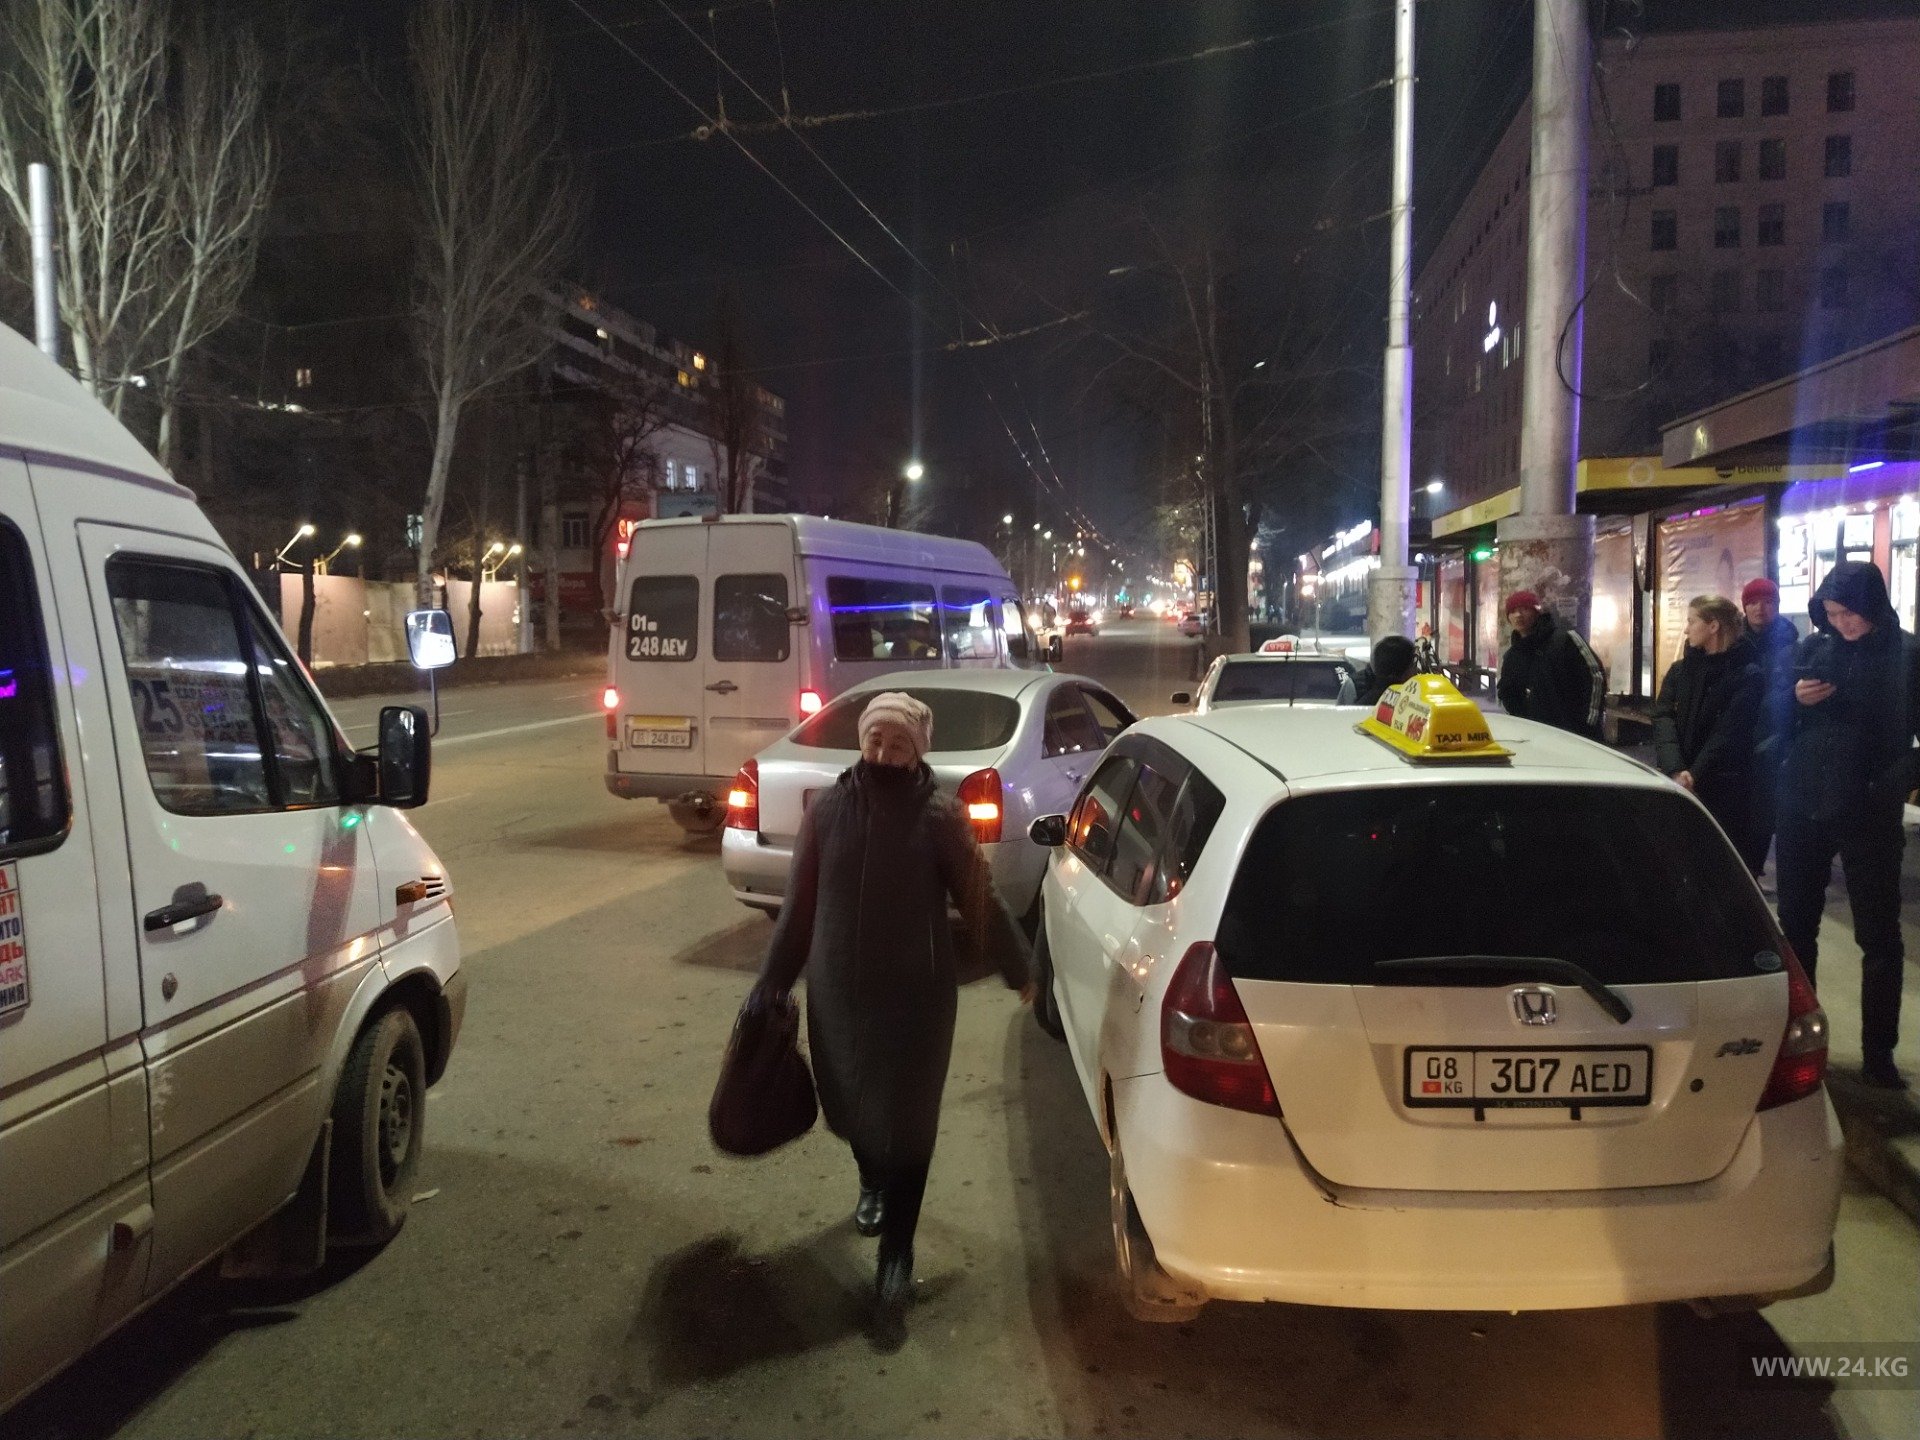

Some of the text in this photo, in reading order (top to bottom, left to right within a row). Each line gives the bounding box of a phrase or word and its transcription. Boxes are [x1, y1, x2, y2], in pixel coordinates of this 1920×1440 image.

[631, 614, 647, 631] 01
[631, 636, 688, 656] 248 AEW
[1435, 732, 1490, 743] TAXI MIR
[1427, 1057, 1457, 1079] 08
[1490, 1058, 1631, 1093] 307 AED
[1444, 1081, 1463, 1093] KG
